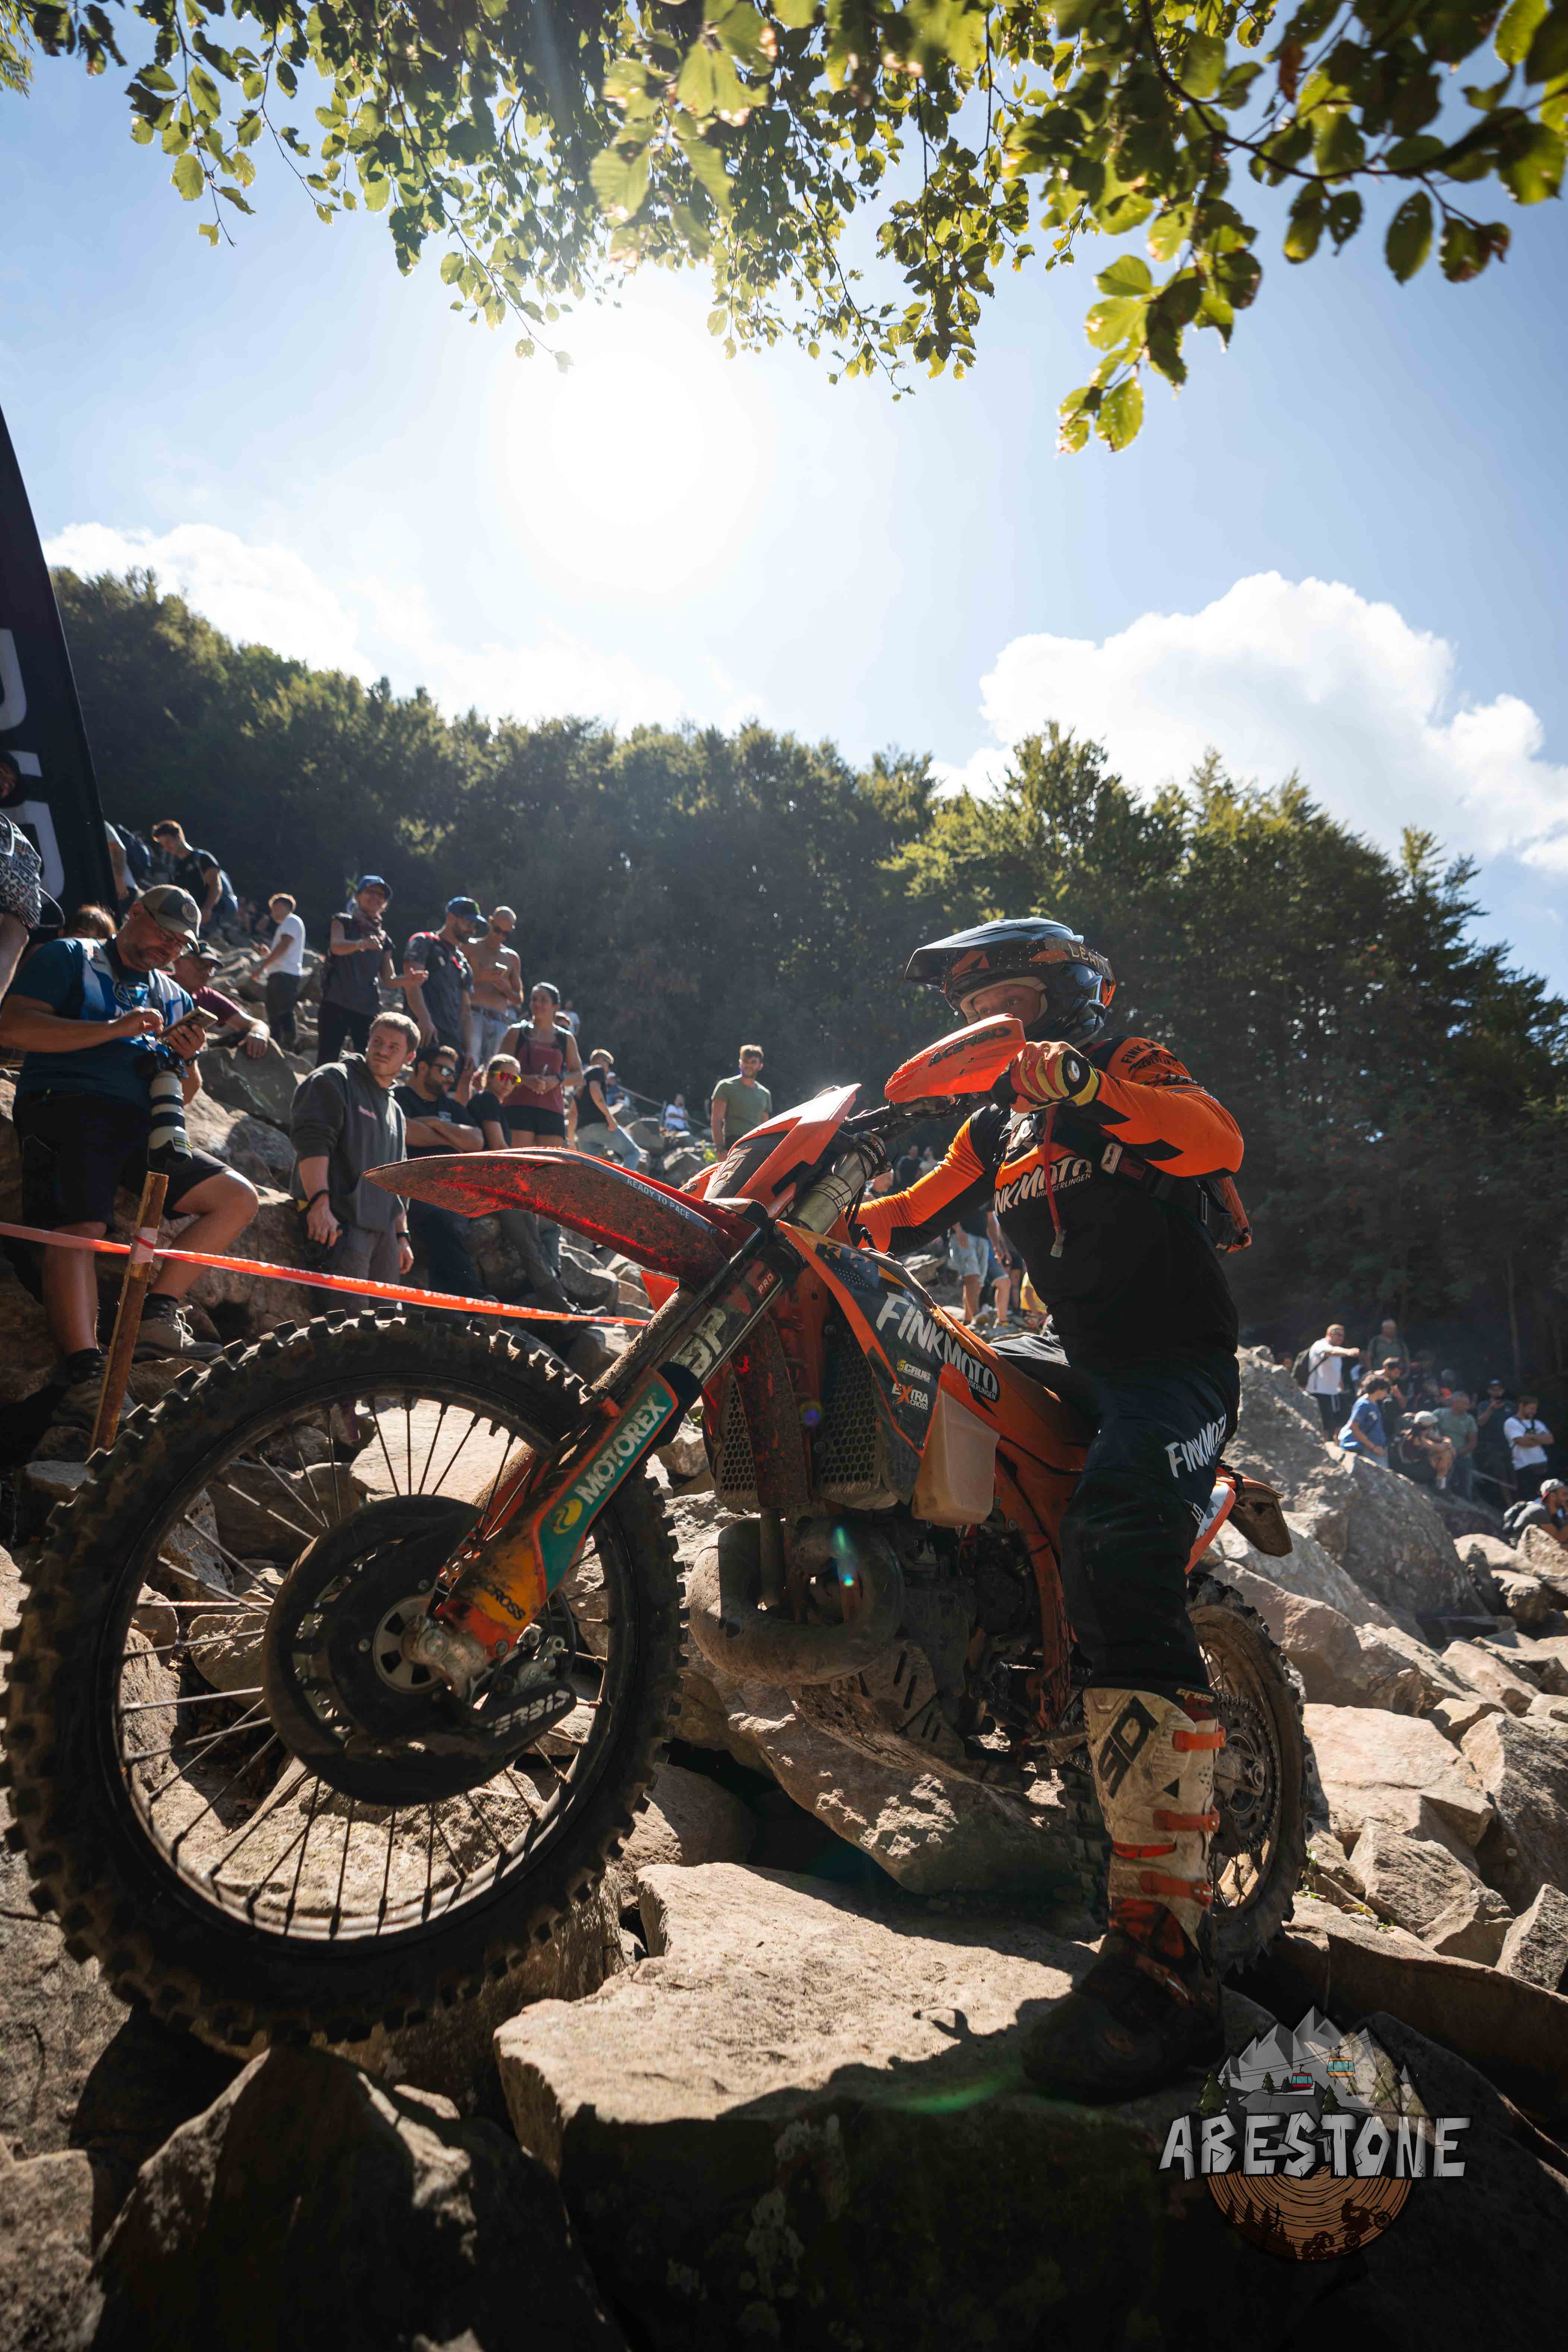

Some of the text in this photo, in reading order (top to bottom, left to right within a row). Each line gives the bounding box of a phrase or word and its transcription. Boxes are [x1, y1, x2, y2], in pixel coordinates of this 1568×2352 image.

[928, 1026, 1012, 1067] ACERBIS
[1120, 1045, 1146, 1063] FINK
[627, 1178, 655, 1197] READY
[657, 1194, 668, 1206] TO
[1036, 1174, 1091, 1199] HOLGERLINGEN
[758, 1272, 773, 1294] PRO
[910, 1400, 928, 1411] CROSS
[574, 1394, 667, 1505] MOTOREX
[1164, 1413, 1227, 1478] FINKMOT
[484, 1582, 526, 1620] CROSS
[487, 1690, 571, 1738] ERBIS
